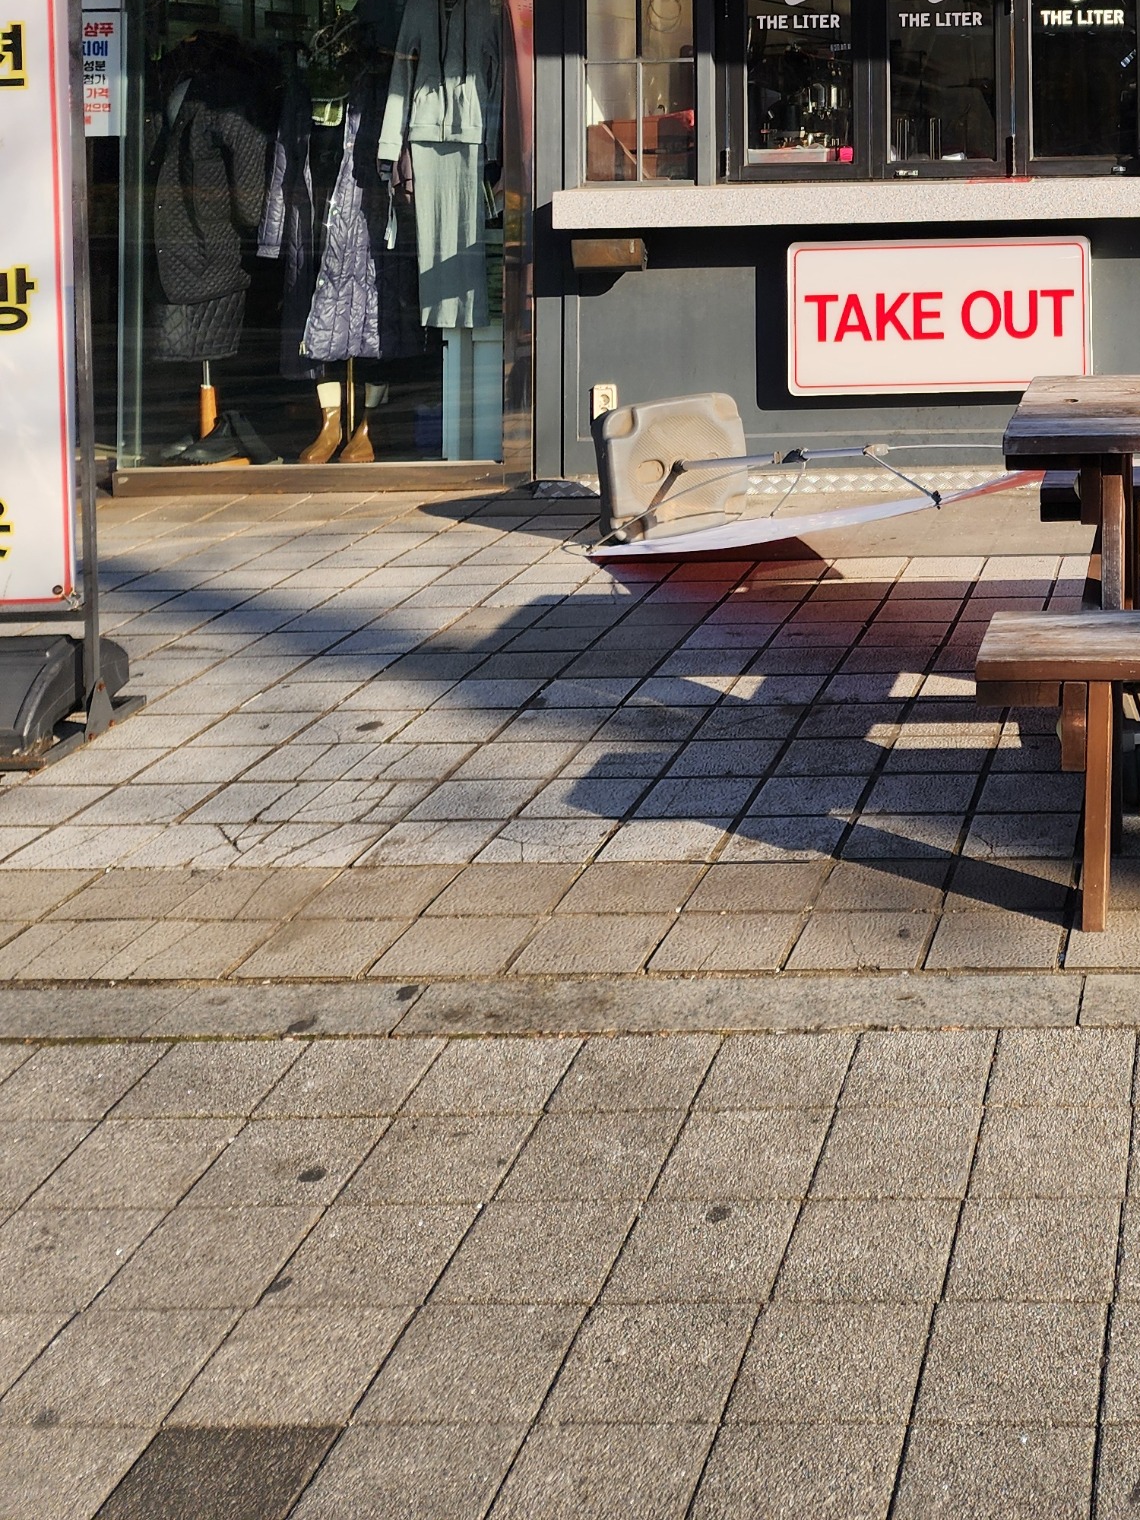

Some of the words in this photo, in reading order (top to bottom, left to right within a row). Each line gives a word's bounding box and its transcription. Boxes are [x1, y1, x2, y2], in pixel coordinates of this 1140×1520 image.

[757, 15, 788, 29] THE
[793, 14, 840, 29] LITER
[899, 12, 930, 27] THE
[935, 12, 983, 27] LITER
[1040, 10, 1072, 26] THE
[1077, 9, 1125, 25] LITER
[84, 22, 113, 37] 샴푸
[84, 60, 106, 72] 성분
[804, 291, 945, 343] TAKE
[960, 288, 1075, 341] OUT
